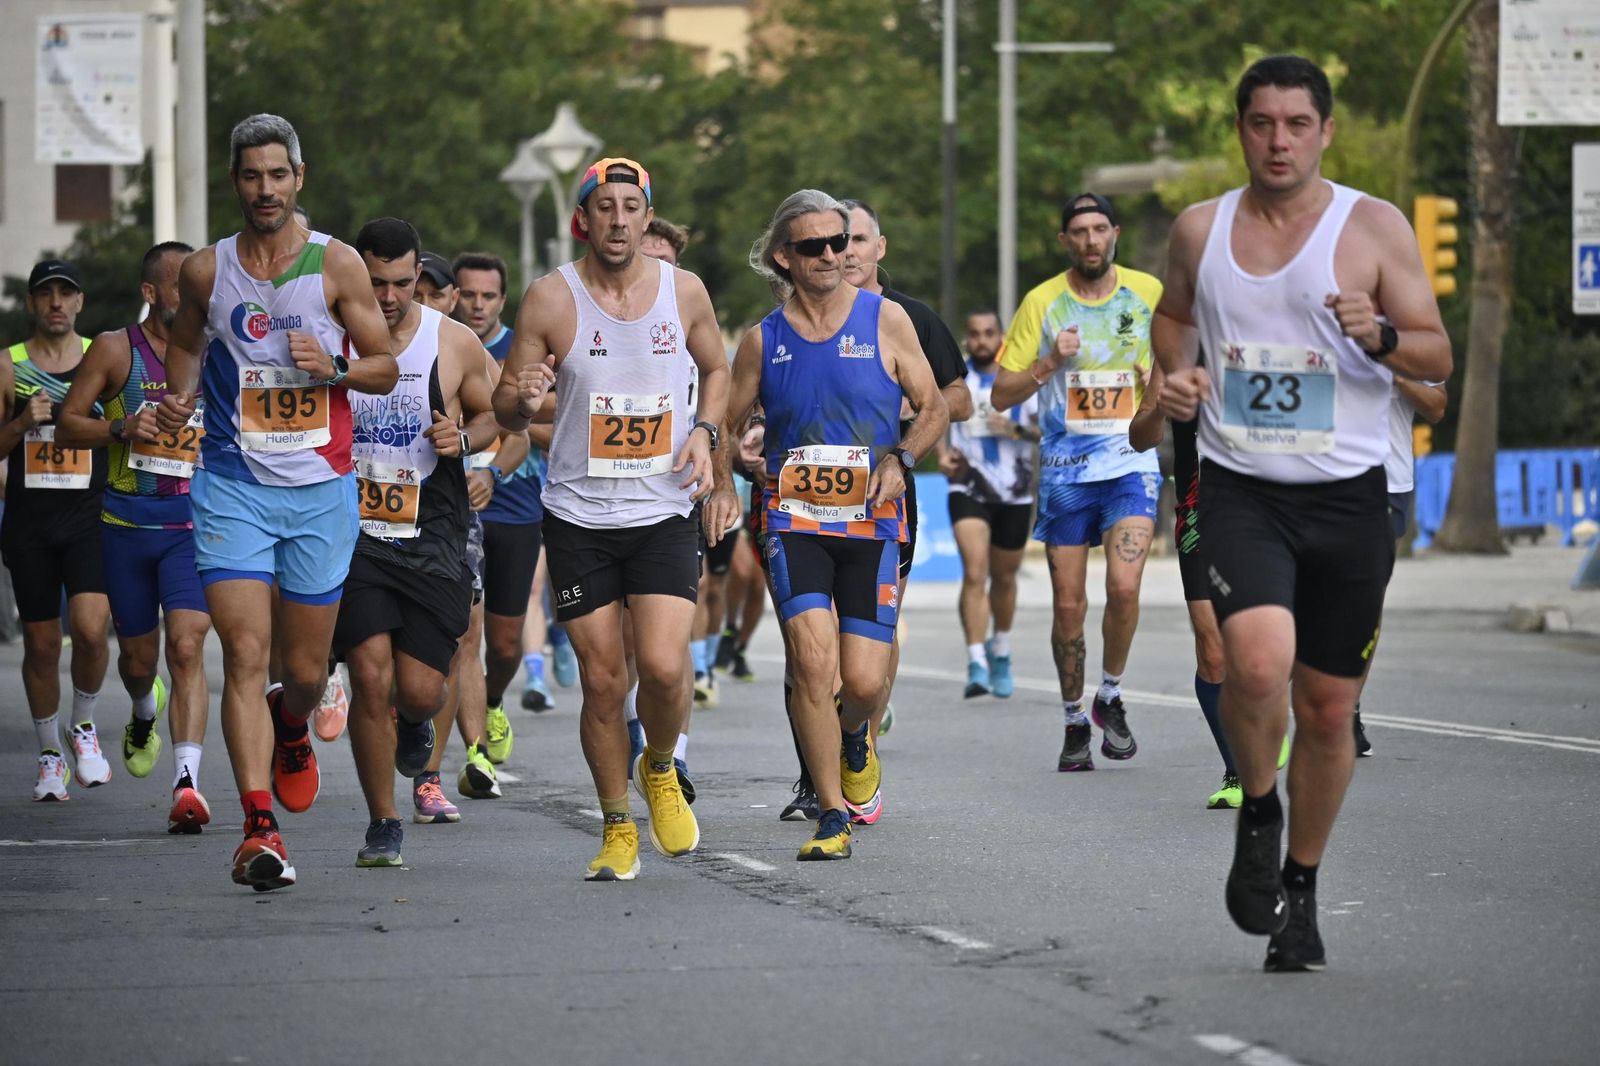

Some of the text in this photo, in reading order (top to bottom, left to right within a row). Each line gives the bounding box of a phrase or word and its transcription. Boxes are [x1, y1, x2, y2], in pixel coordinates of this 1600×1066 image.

[1306, 351, 1329, 368] 2K
[245, 370, 264, 383] 2K
[1071, 374, 1080, 383] 2K
[1117, 373, 1129, 382] 2K
[140, 382, 167, 390] KIA
[1076, 388, 1124, 411] 287
[1248, 373, 1301, 413] 23
[257, 389, 316, 419] 195
[349, 394, 423, 414] UNNERS
[359, 402, 420, 432] Palmera
[604, 416, 663, 446] 257
[1247, 429, 1297, 444] Huelva
[144, 426, 197, 452] 32
[266, 434, 304, 444] Huelva
[35, 442, 78, 464] 481
[792, 450, 804, 461] 2K
[848, 450, 862, 462] 2K
[148, 458, 182, 470] Huelva
[352, 460, 360, 472] K
[614, 460, 651, 470] Huelva
[397, 468, 414, 481] 2K
[794, 466, 854, 494] 359
[802, 502, 838, 516] Huelva
[360, 521, 386, 530] elva
